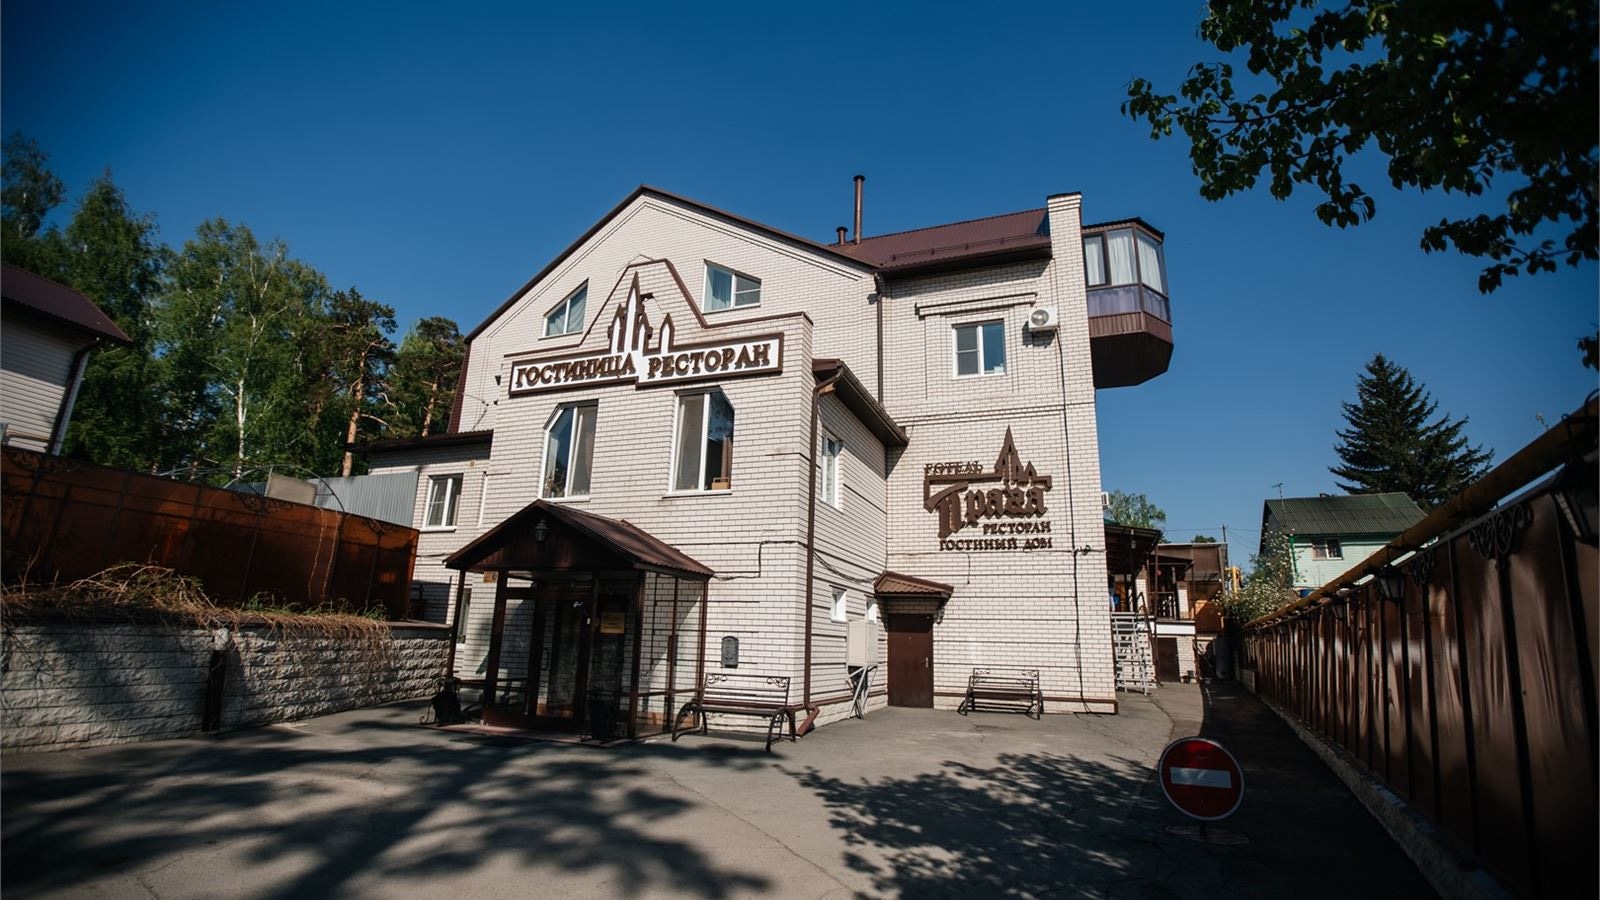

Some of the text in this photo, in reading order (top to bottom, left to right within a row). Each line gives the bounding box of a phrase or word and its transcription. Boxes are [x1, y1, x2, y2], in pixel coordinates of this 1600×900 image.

[516, 344, 770, 388] ГОСТИНИЦА РЕСТОРАН
[983, 521, 1051, 535] РЕСТОРАН
[1023, 537, 1052, 551] ДОМ
